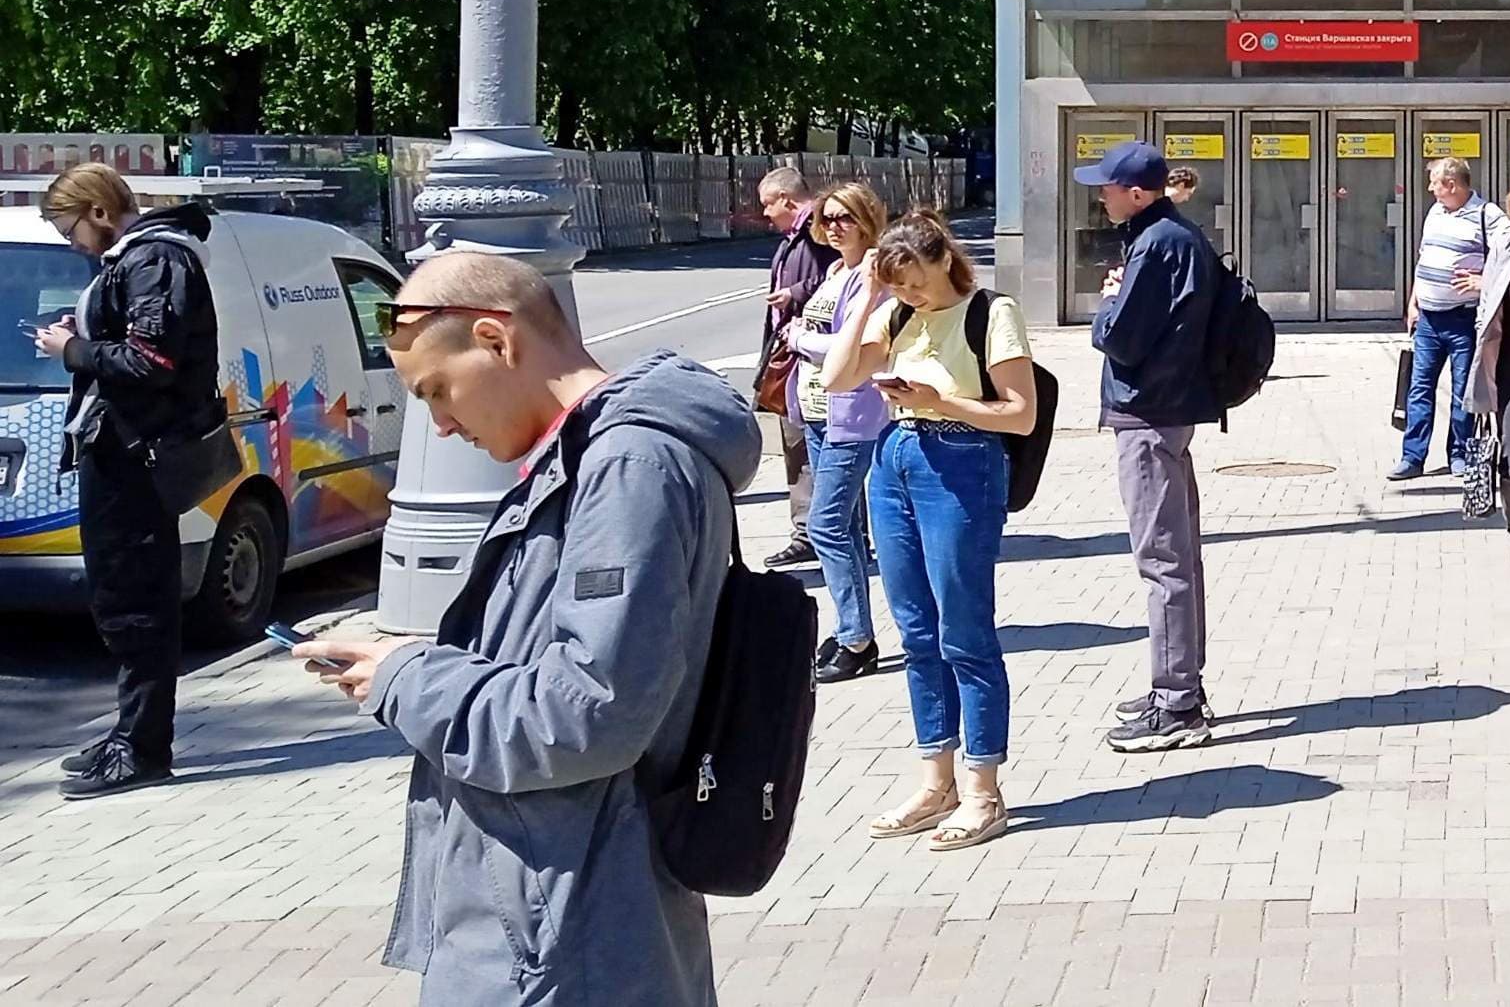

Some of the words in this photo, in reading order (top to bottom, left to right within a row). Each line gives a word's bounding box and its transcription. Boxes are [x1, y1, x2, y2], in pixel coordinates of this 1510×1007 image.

[1284, 33, 1321, 43] Станция
[1322, 33, 1375, 44] Варшавская
[1376, 35, 1412, 44] закрыта
[304, 284, 340, 301] Outdoor
